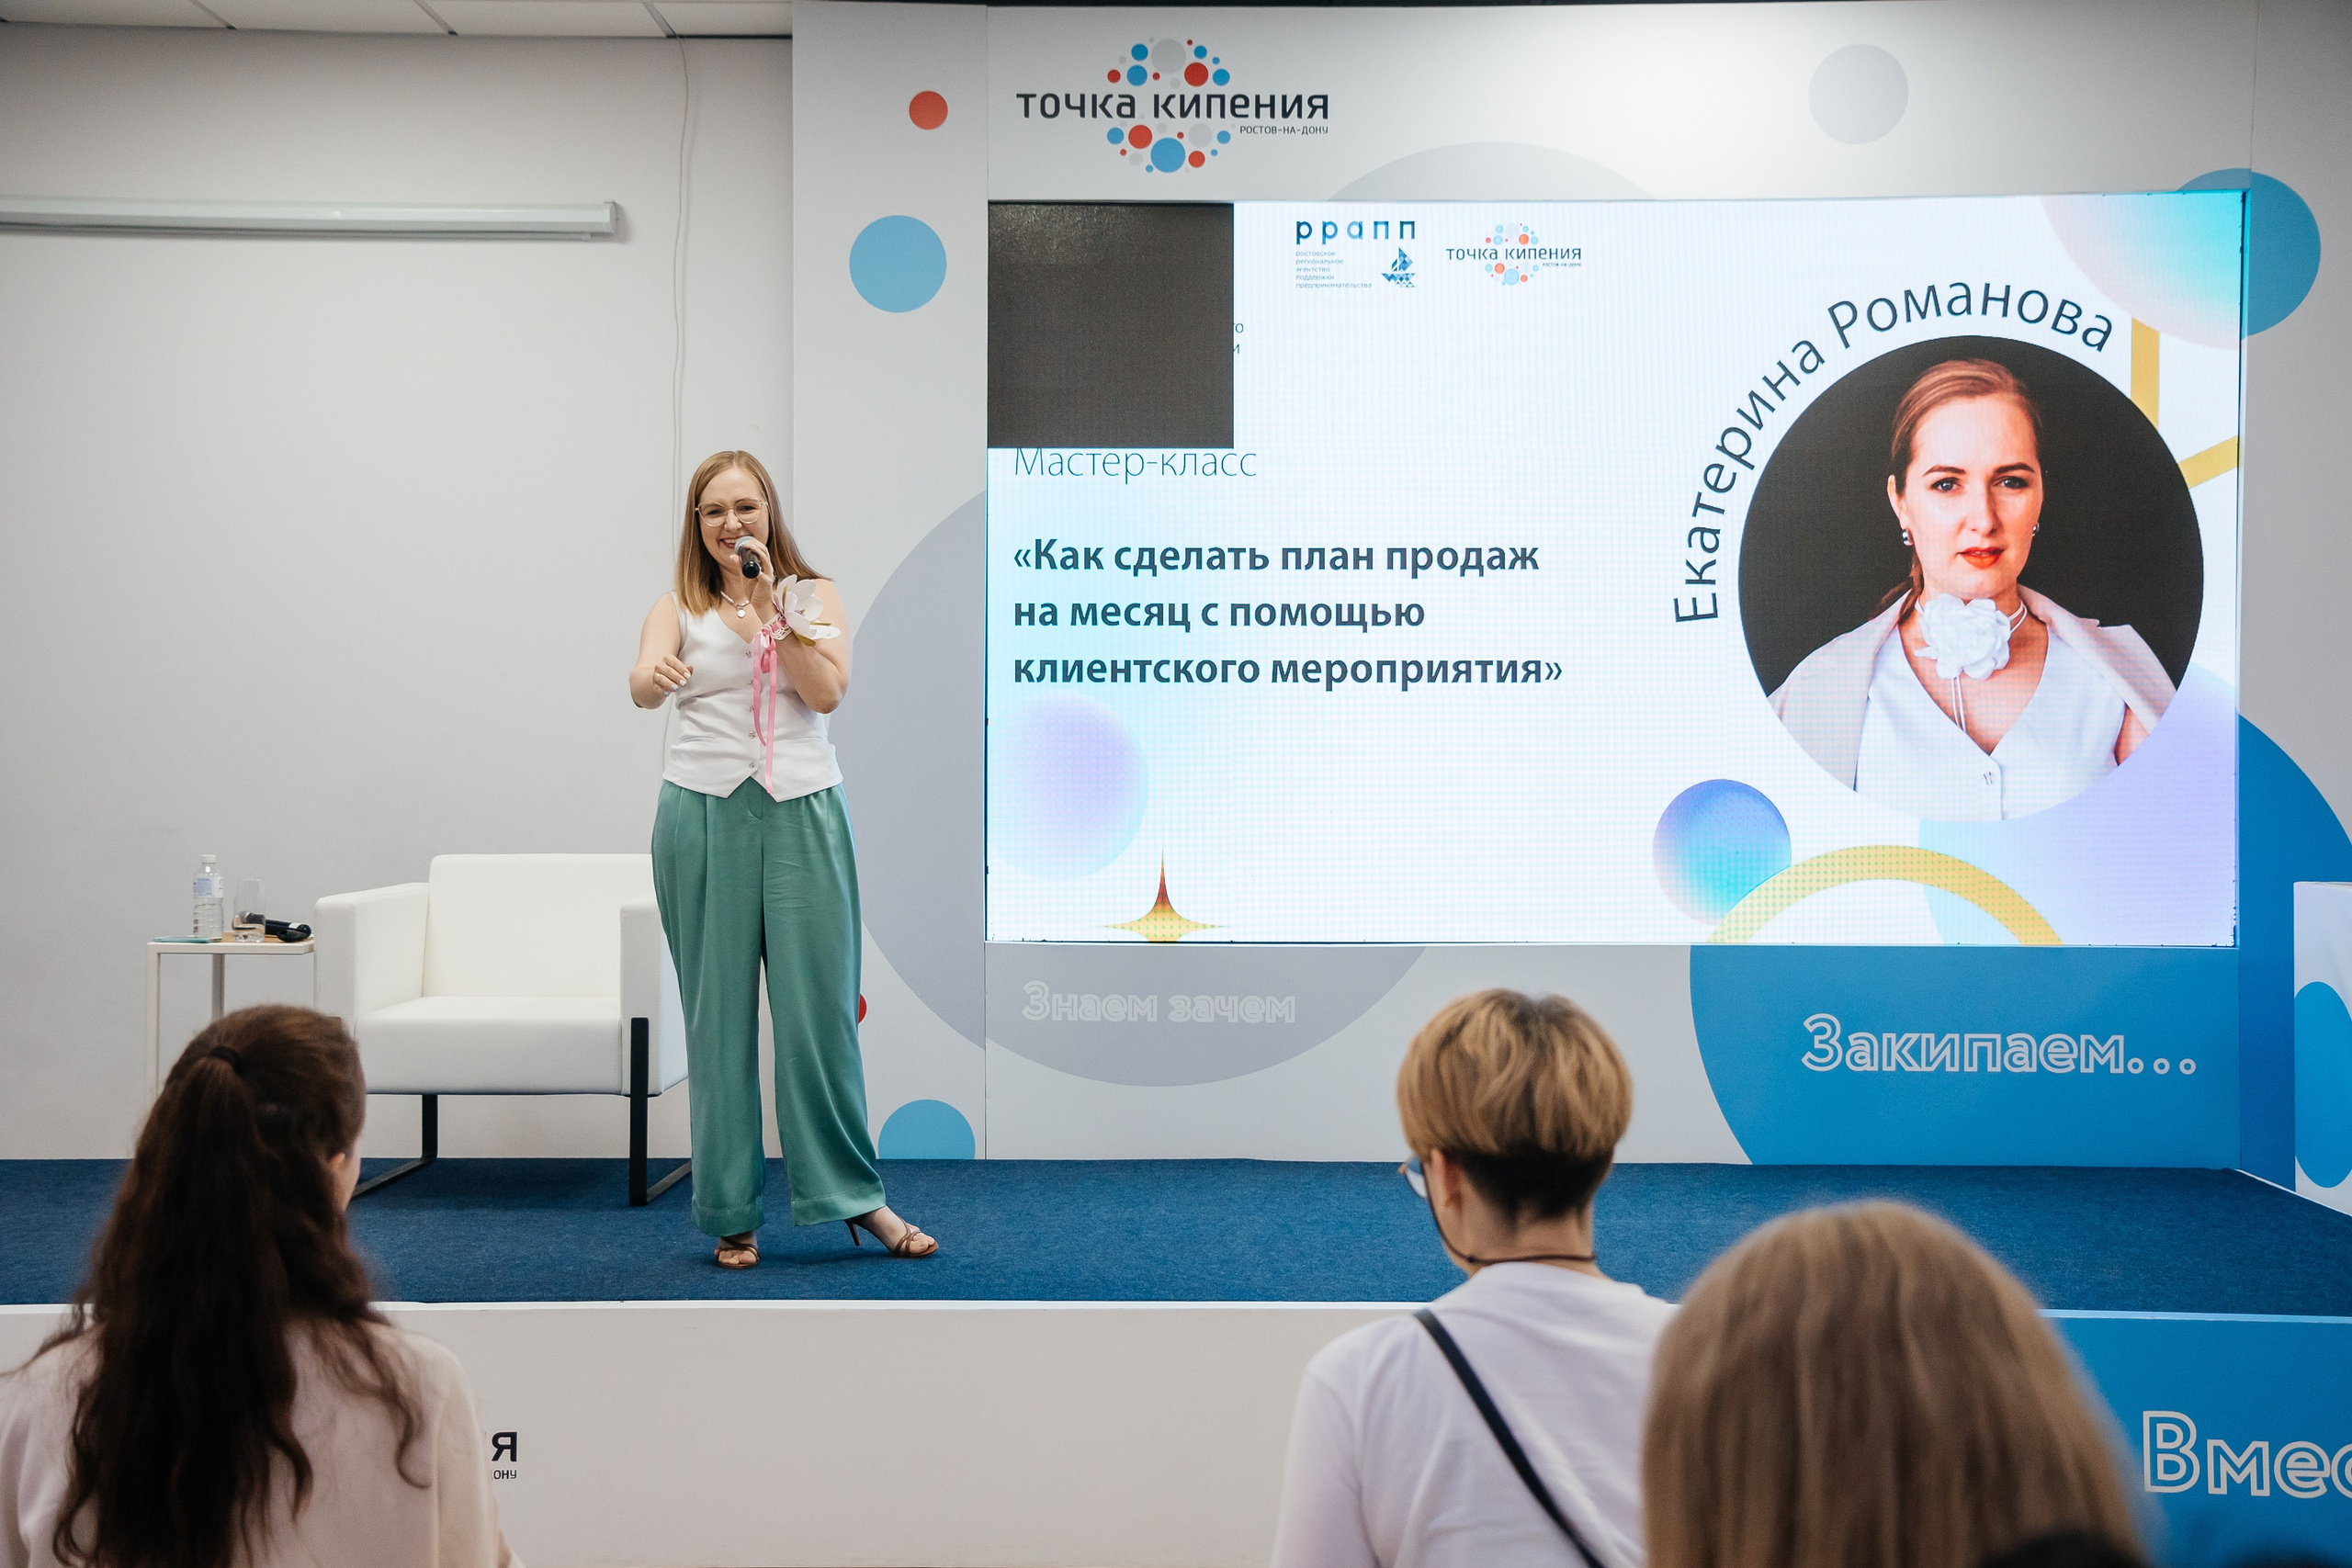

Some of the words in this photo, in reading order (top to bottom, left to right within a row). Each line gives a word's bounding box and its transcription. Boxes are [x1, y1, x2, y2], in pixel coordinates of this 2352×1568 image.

[1015, 93, 1136, 119] точка
[1153, 93, 1329, 120] кипения
[1239, 125, 1329, 136] РОСТОВ-НА-ДОНУ
[1445, 248, 1498, 261] точка
[1505, 247, 1582, 261] кипения
[1014, 447, 1257, 485] Мастер-класс
[1674, 338, 1826, 623] Екатерина
[1827, 281, 2113, 353] Романова
[1013, 537, 1104, 570] «Как
[1114, 546, 1270, 578] сделать
[1281, 547, 1374, 570] план
[1386, 547, 1541, 580] продаж
[1013, 602, 1058, 626] на
[1069, 602, 1191, 634] месяц
[1201, 602, 1219, 626] с
[1230, 602, 1425, 634] помощью
[1013, 659, 1261, 683] клиентского
[1272, 659, 1564, 693] мероприятия»
[1021, 979, 1159, 1022] Знаем
[1167, 994, 1296, 1024] зачем
[1801, 1012, 2197, 1076] Закипаем...
